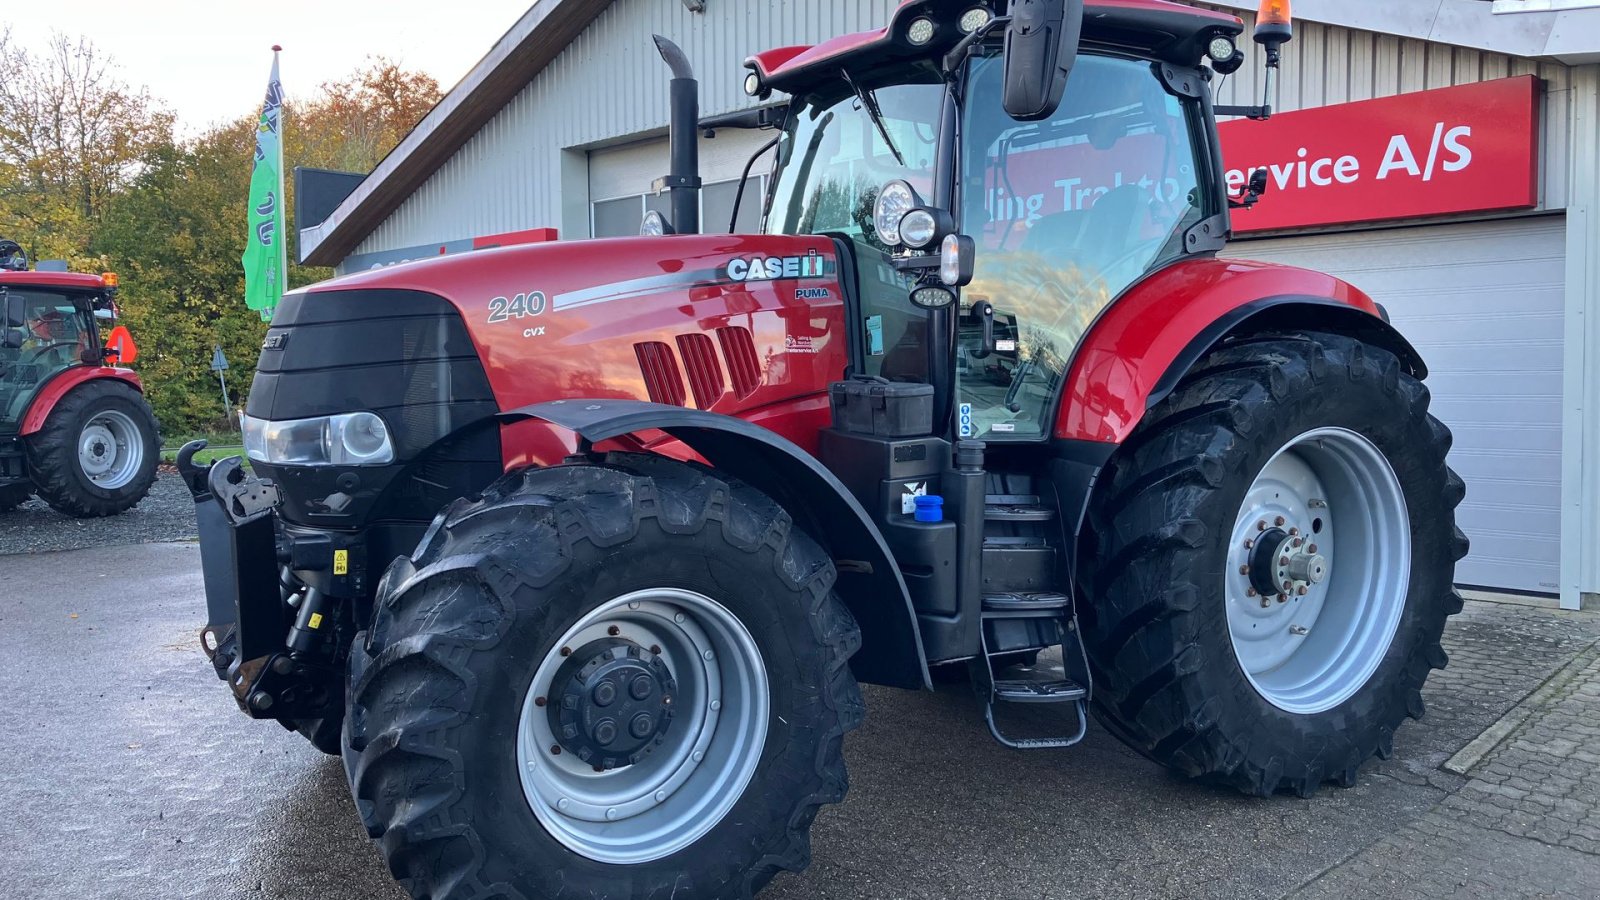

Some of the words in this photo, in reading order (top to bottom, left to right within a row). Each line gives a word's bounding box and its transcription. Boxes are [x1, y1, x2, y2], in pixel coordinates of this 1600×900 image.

[985, 187, 1044, 228] ling
[1376, 122, 1472, 181] A/S
[795, 288, 829, 299] PUMA
[487, 290, 546, 323] 240
[523, 326, 545, 338] CVX
